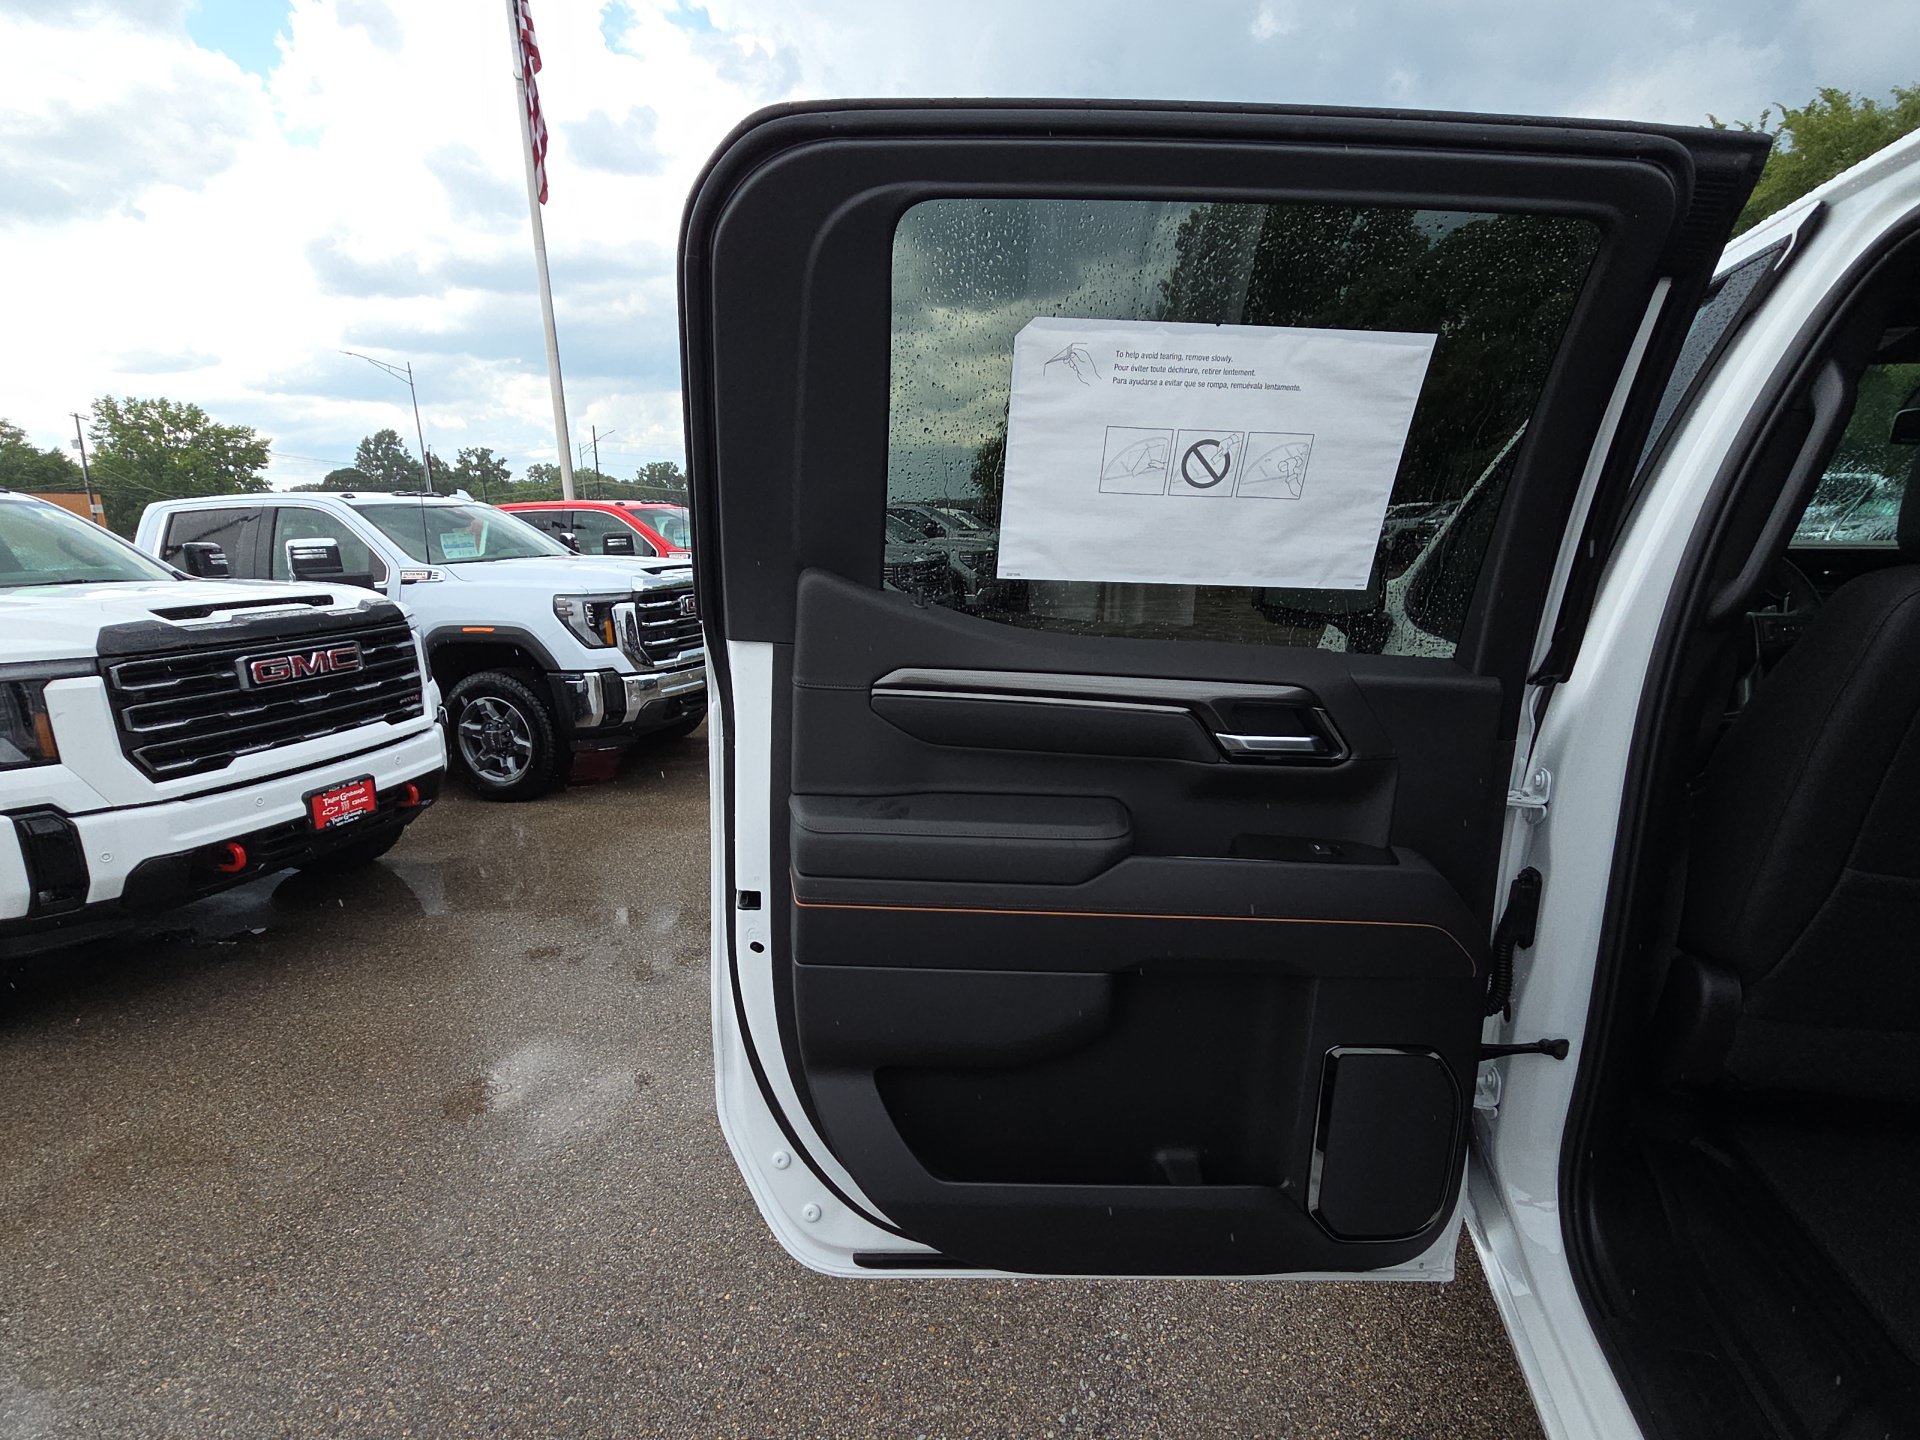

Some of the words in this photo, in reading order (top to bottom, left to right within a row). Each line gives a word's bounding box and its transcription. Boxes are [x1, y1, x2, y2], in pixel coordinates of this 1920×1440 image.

[1116, 350, 1124, 358] To
[1125, 350, 1139, 360] help
[1141, 351, 1158, 360] avoid
[1160, 352, 1184, 362] tearing,
[1186, 354, 1209, 362] remove
[1211, 354, 1233, 364] slowly.
[1114, 363, 1129, 371] Pour
[1131, 363, 1149, 373] éviter
[1150, 365, 1166, 373] toute
[1168, 365, 1200, 375] déchirure,
[1201, 367, 1222, 376] retirer
[1223, 368, 1256, 377] lentement.
[1112, 376, 1127, 385] Para
[1129, 377, 1158, 387] ayudarse
[1165, 379, 1183, 387] evitar
[1184, 380, 1196, 389] que
[1207, 381, 1229, 390] rompa,
[1230, 381, 1263, 390] remuévala
[1264, 382, 1302, 392] lentamente.
[250, 645, 360, 685] GMC
[351, 795, 369, 806] GMC
